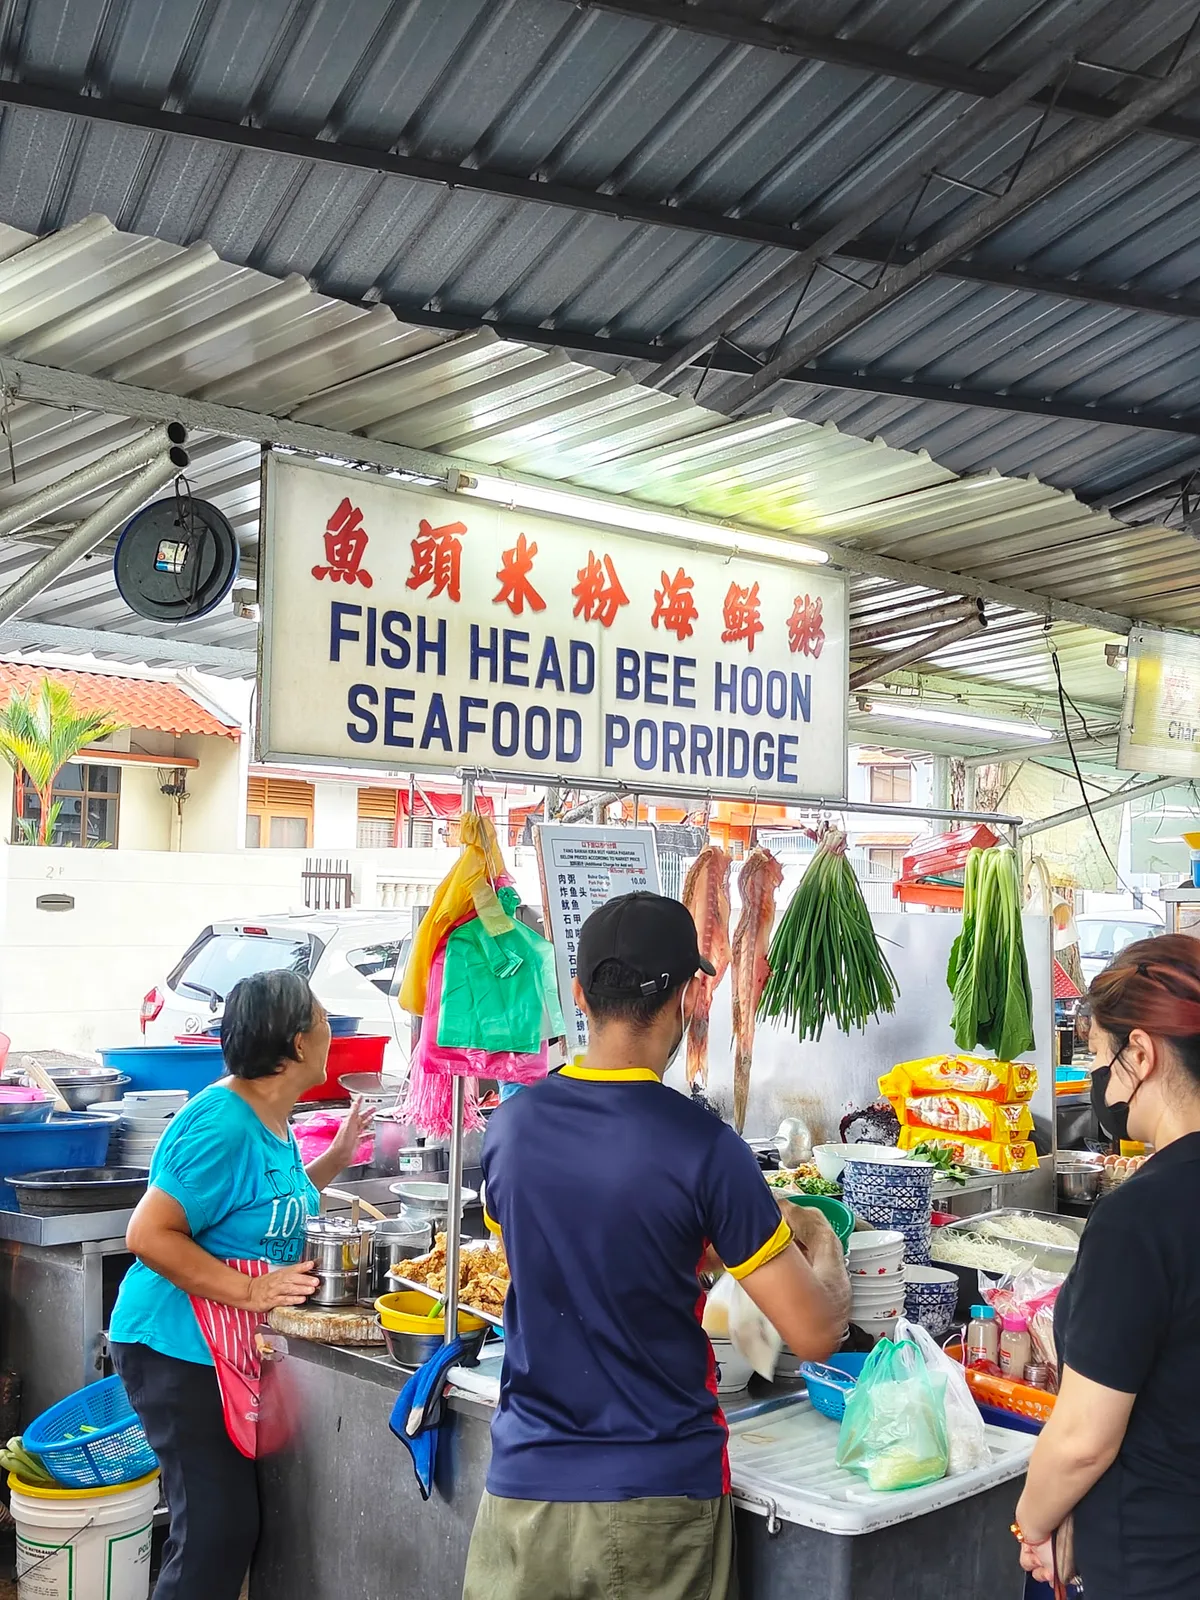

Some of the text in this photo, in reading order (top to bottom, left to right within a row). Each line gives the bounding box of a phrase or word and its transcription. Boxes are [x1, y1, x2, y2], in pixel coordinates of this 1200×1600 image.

[312, 498, 825, 660] 魚頭米粉海鮮粥
[331, 602, 811, 723] FISH HEAD BEE HOON
[348, 684, 798, 784] SEAFOOD PORRIDGE
[558, 874, 576, 884] 肉粥
[631, 877, 647, 885] 10.00
[560, 887, 587, 898] 炸鱼头
